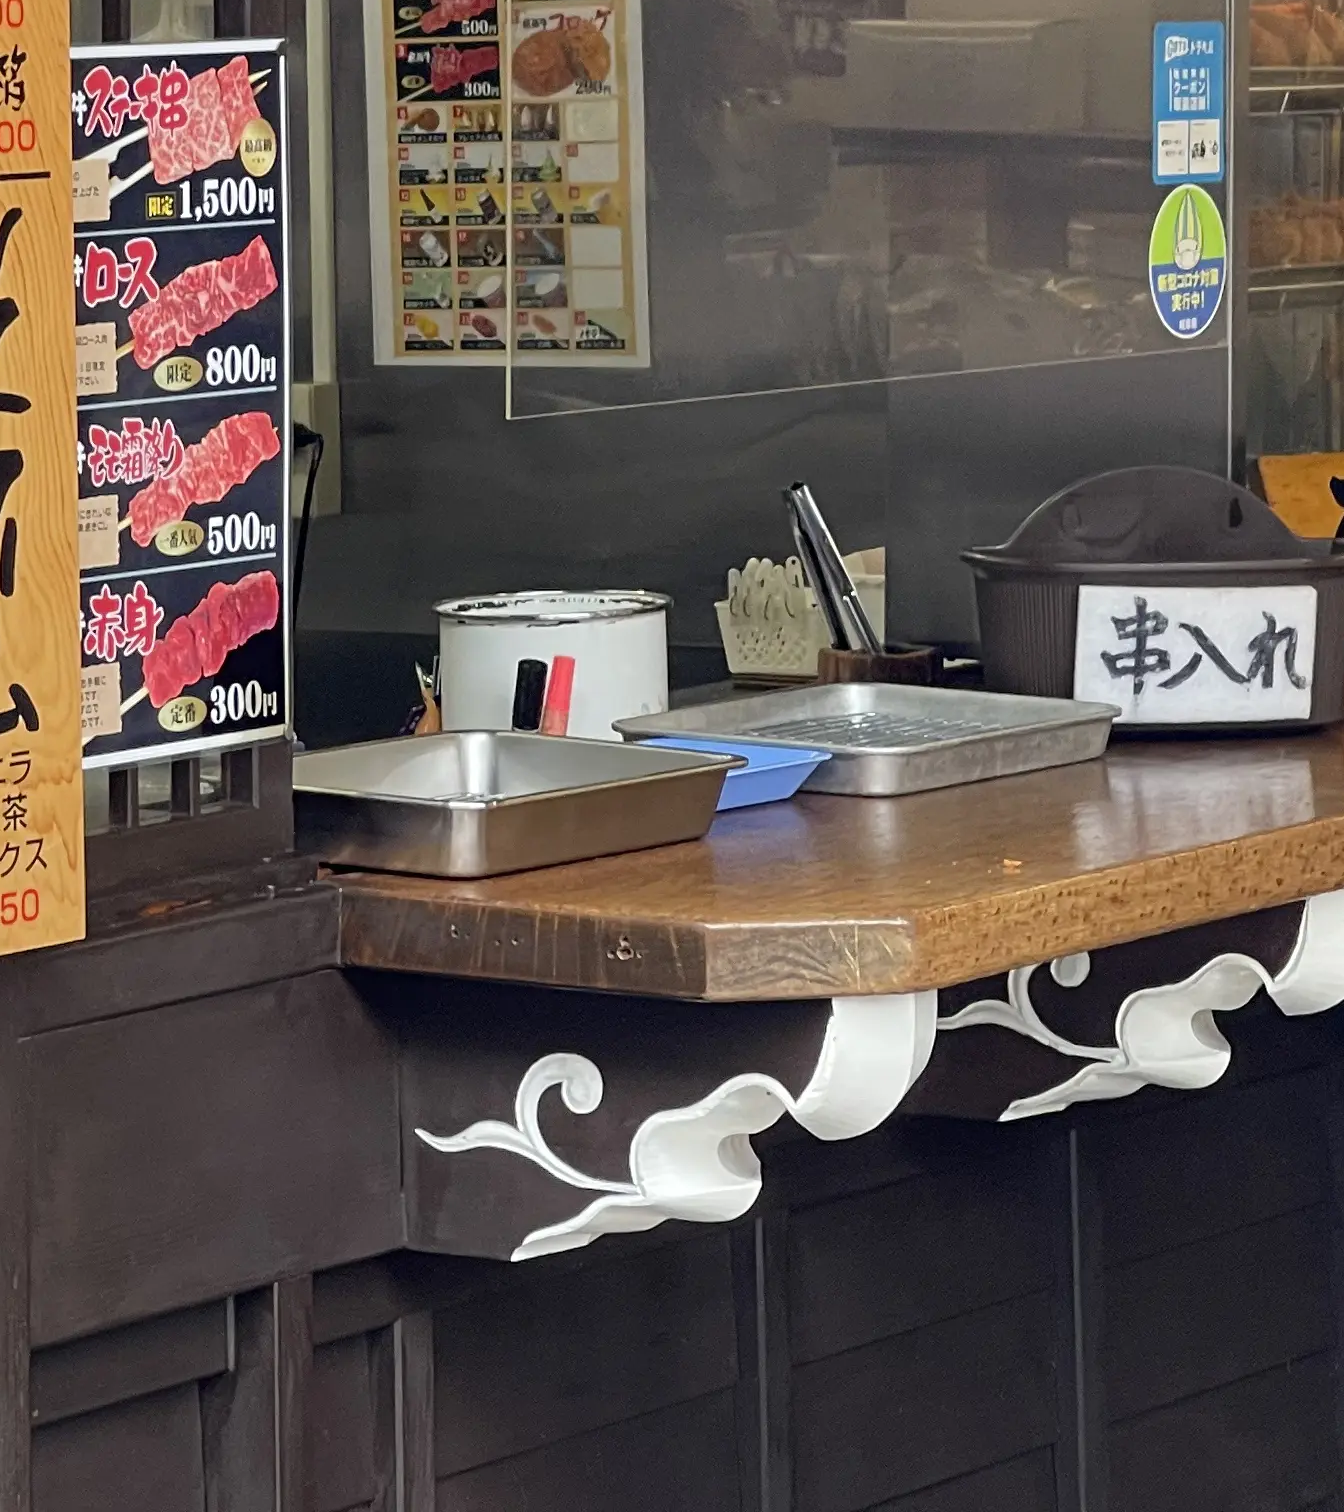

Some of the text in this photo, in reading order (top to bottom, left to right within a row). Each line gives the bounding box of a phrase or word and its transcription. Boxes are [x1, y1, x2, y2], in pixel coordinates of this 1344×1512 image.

[83, 59, 191, 140] ステーキ串
[147, 176, 275, 224] 限定 1,500円
[83, 236, 160, 311] ロース
[165, 360, 193, 385] 限定
[204, 343, 277, 387] 800円
[206, 510, 277, 557] 500円
[83, 580, 164, 663] 赤身
[1099, 594, 1307, 696] 串入れ
[170, 705, 196, 726] 定番
[210, 679, 278, 725] 300円
